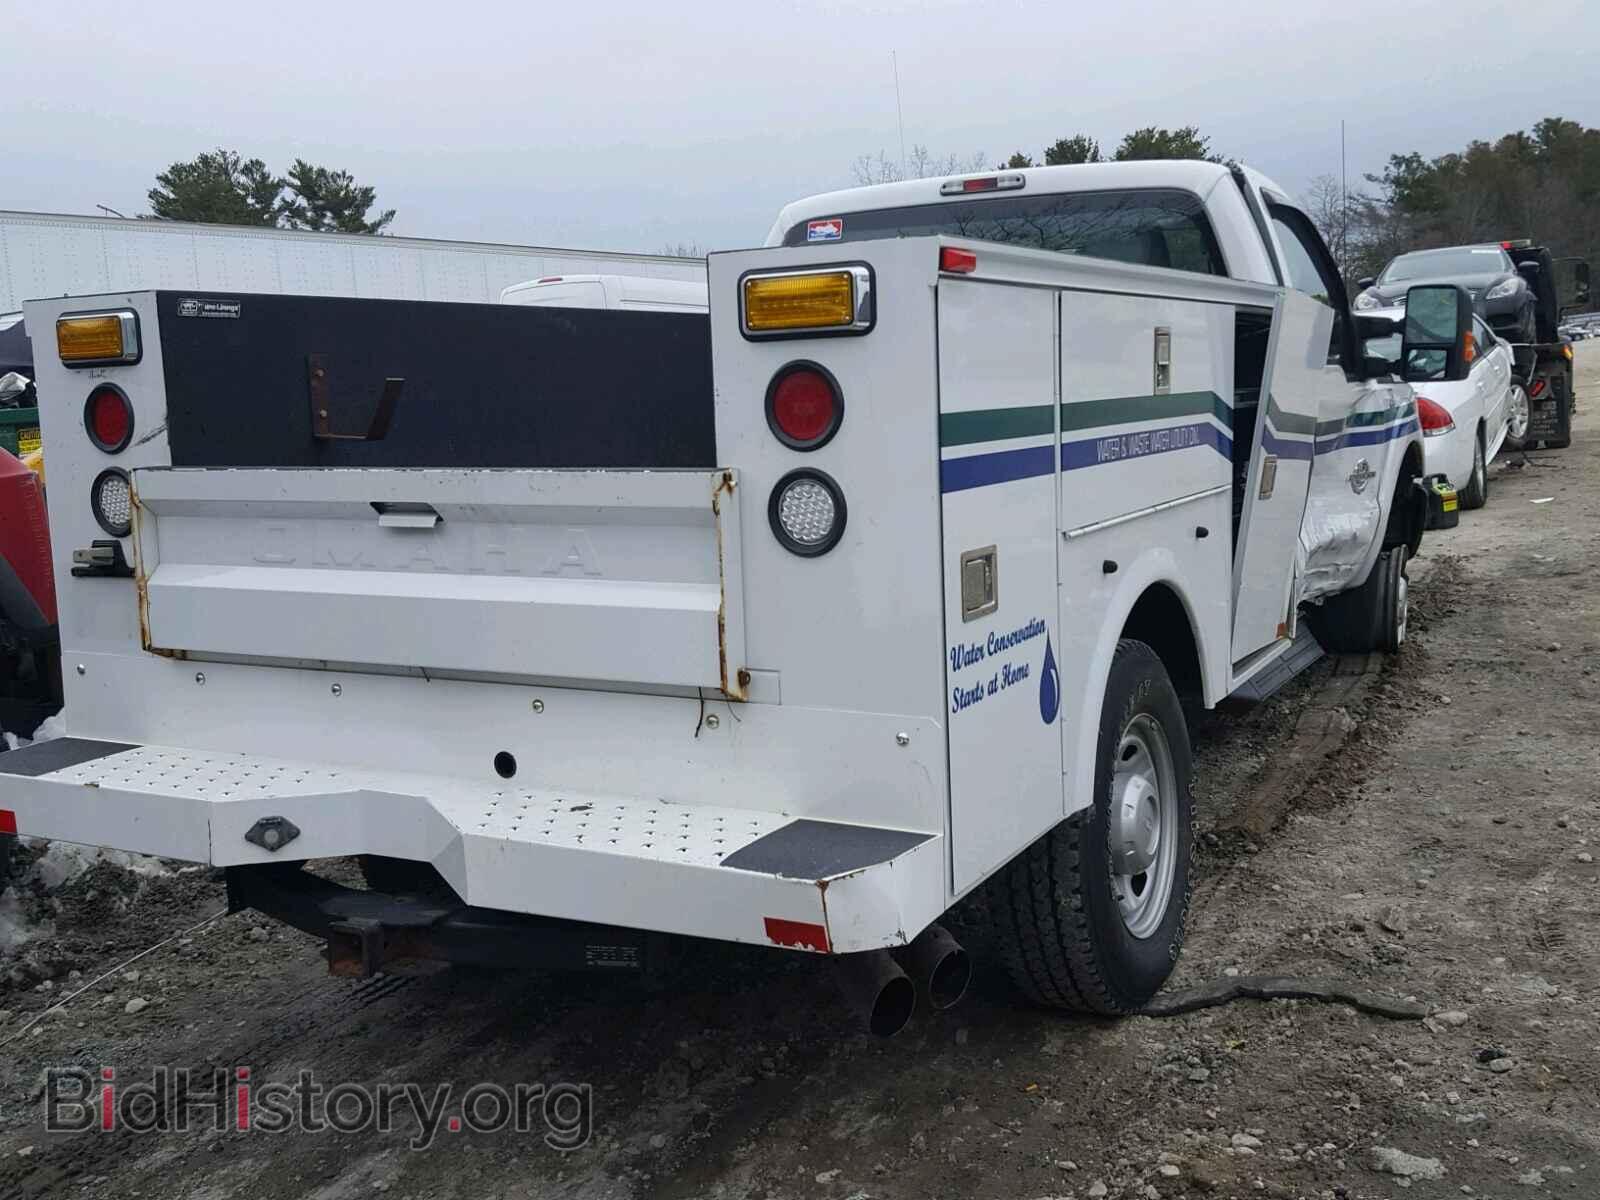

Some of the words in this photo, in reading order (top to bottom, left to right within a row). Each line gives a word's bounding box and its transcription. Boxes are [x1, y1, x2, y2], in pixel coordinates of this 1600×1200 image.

[20, 430, 40, 440] CAUTIO
[950, 643, 985, 672] Water
[987, 616, 1045, 657] Conservation
[952, 680, 985, 714] Starts
[987, 672, 999, 696] at
[1001, 661, 1030, 690] Home
